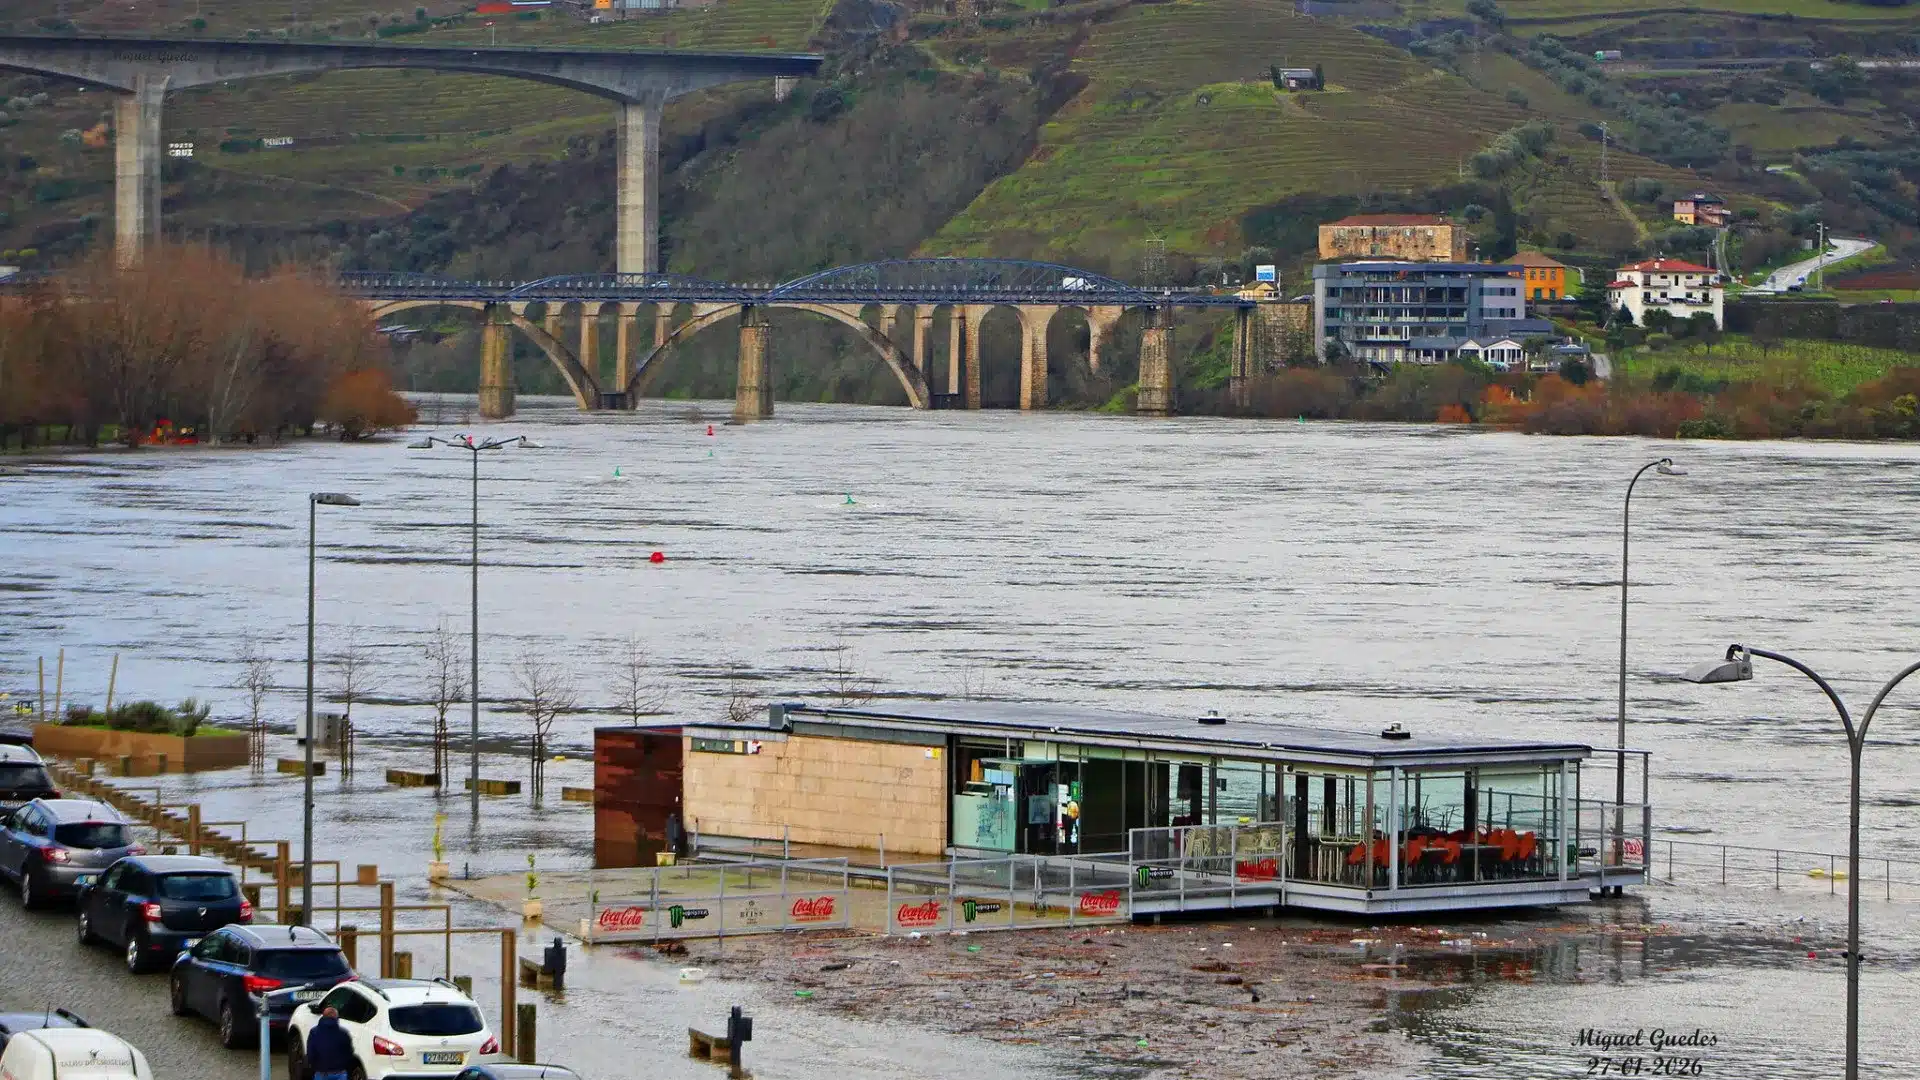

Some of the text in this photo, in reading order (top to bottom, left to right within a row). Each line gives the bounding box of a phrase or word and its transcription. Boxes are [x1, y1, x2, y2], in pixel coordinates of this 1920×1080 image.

[168, 149, 194, 157] CRUZ
[792, 897, 835, 916] Coca-Cola
[898, 902, 939, 920] Coca-Cola
[600, 906, 645, 926] Coca-Cola
